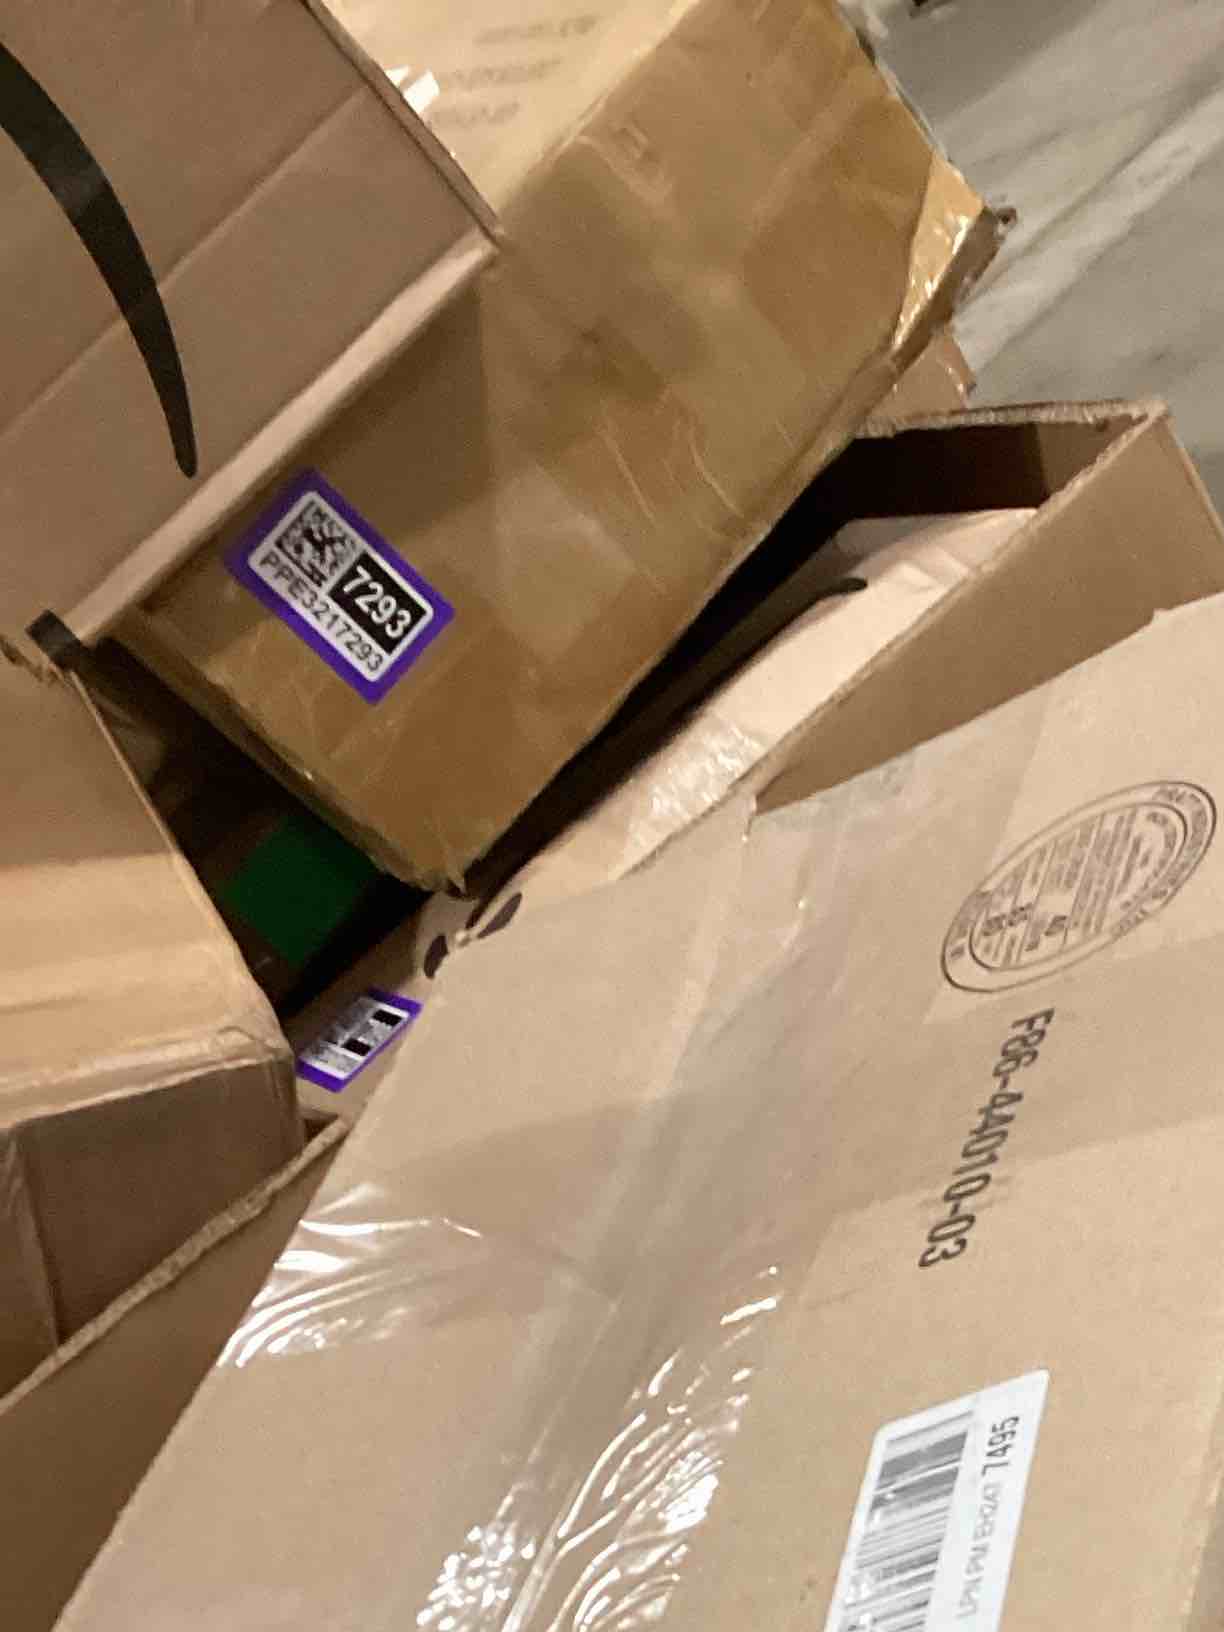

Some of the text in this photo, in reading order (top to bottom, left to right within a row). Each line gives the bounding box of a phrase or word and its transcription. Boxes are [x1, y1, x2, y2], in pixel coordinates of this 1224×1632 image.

[260, 551, 384, 672] PPE3217293
[343, 565, 412, 638] 7293
[918, 1008, 1055, 1268] F86-44010-03
[981, 1415, 1020, 1477] 7495
